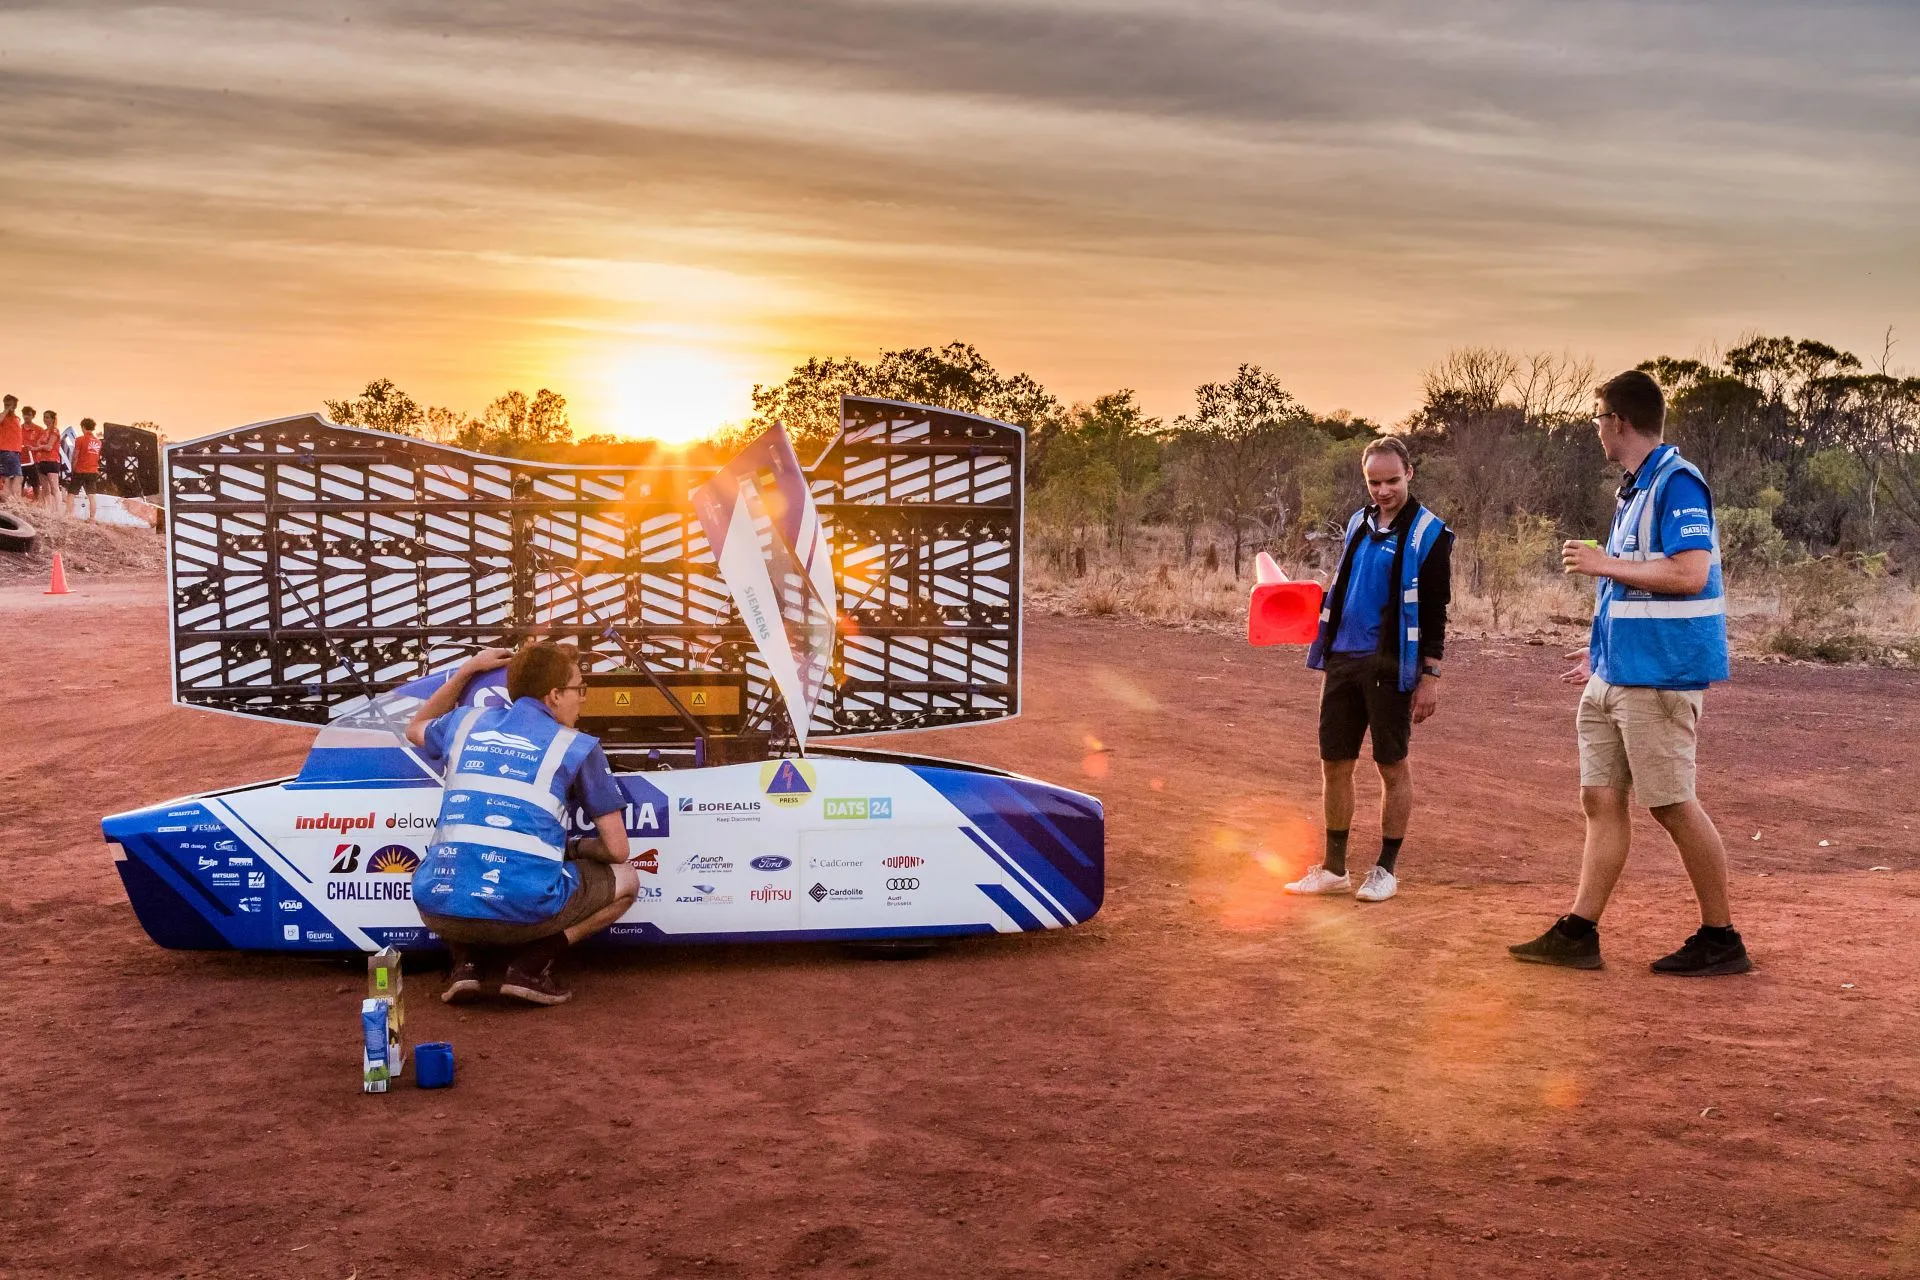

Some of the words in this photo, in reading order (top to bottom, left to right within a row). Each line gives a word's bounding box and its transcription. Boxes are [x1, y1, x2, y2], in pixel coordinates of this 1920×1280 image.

[744, 586, 770, 640] SIEMENS
[489, 747, 515, 757] SOLAR
[517, 752, 538, 762] TEAM
[698, 802, 761, 811] BOREALIS
[826, 801, 865, 816] DATS
[871, 801, 890, 815] 24
[296, 812, 375, 834] indupol
[481, 851, 507, 864] FUJITSU
[758, 858, 783, 868] Ford
[818, 859, 864, 868] CadCorner
[887, 856, 921, 869] DUPONT
[691, 862, 734, 870] powertrain
[327, 882, 411, 900] CHALLENGE
[750, 885, 792, 903] FUJITSU
[829, 888, 863, 896] Cardolite
[278, 901, 303, 910] VDAB
[610, 926, 643, 934] Klarrio
